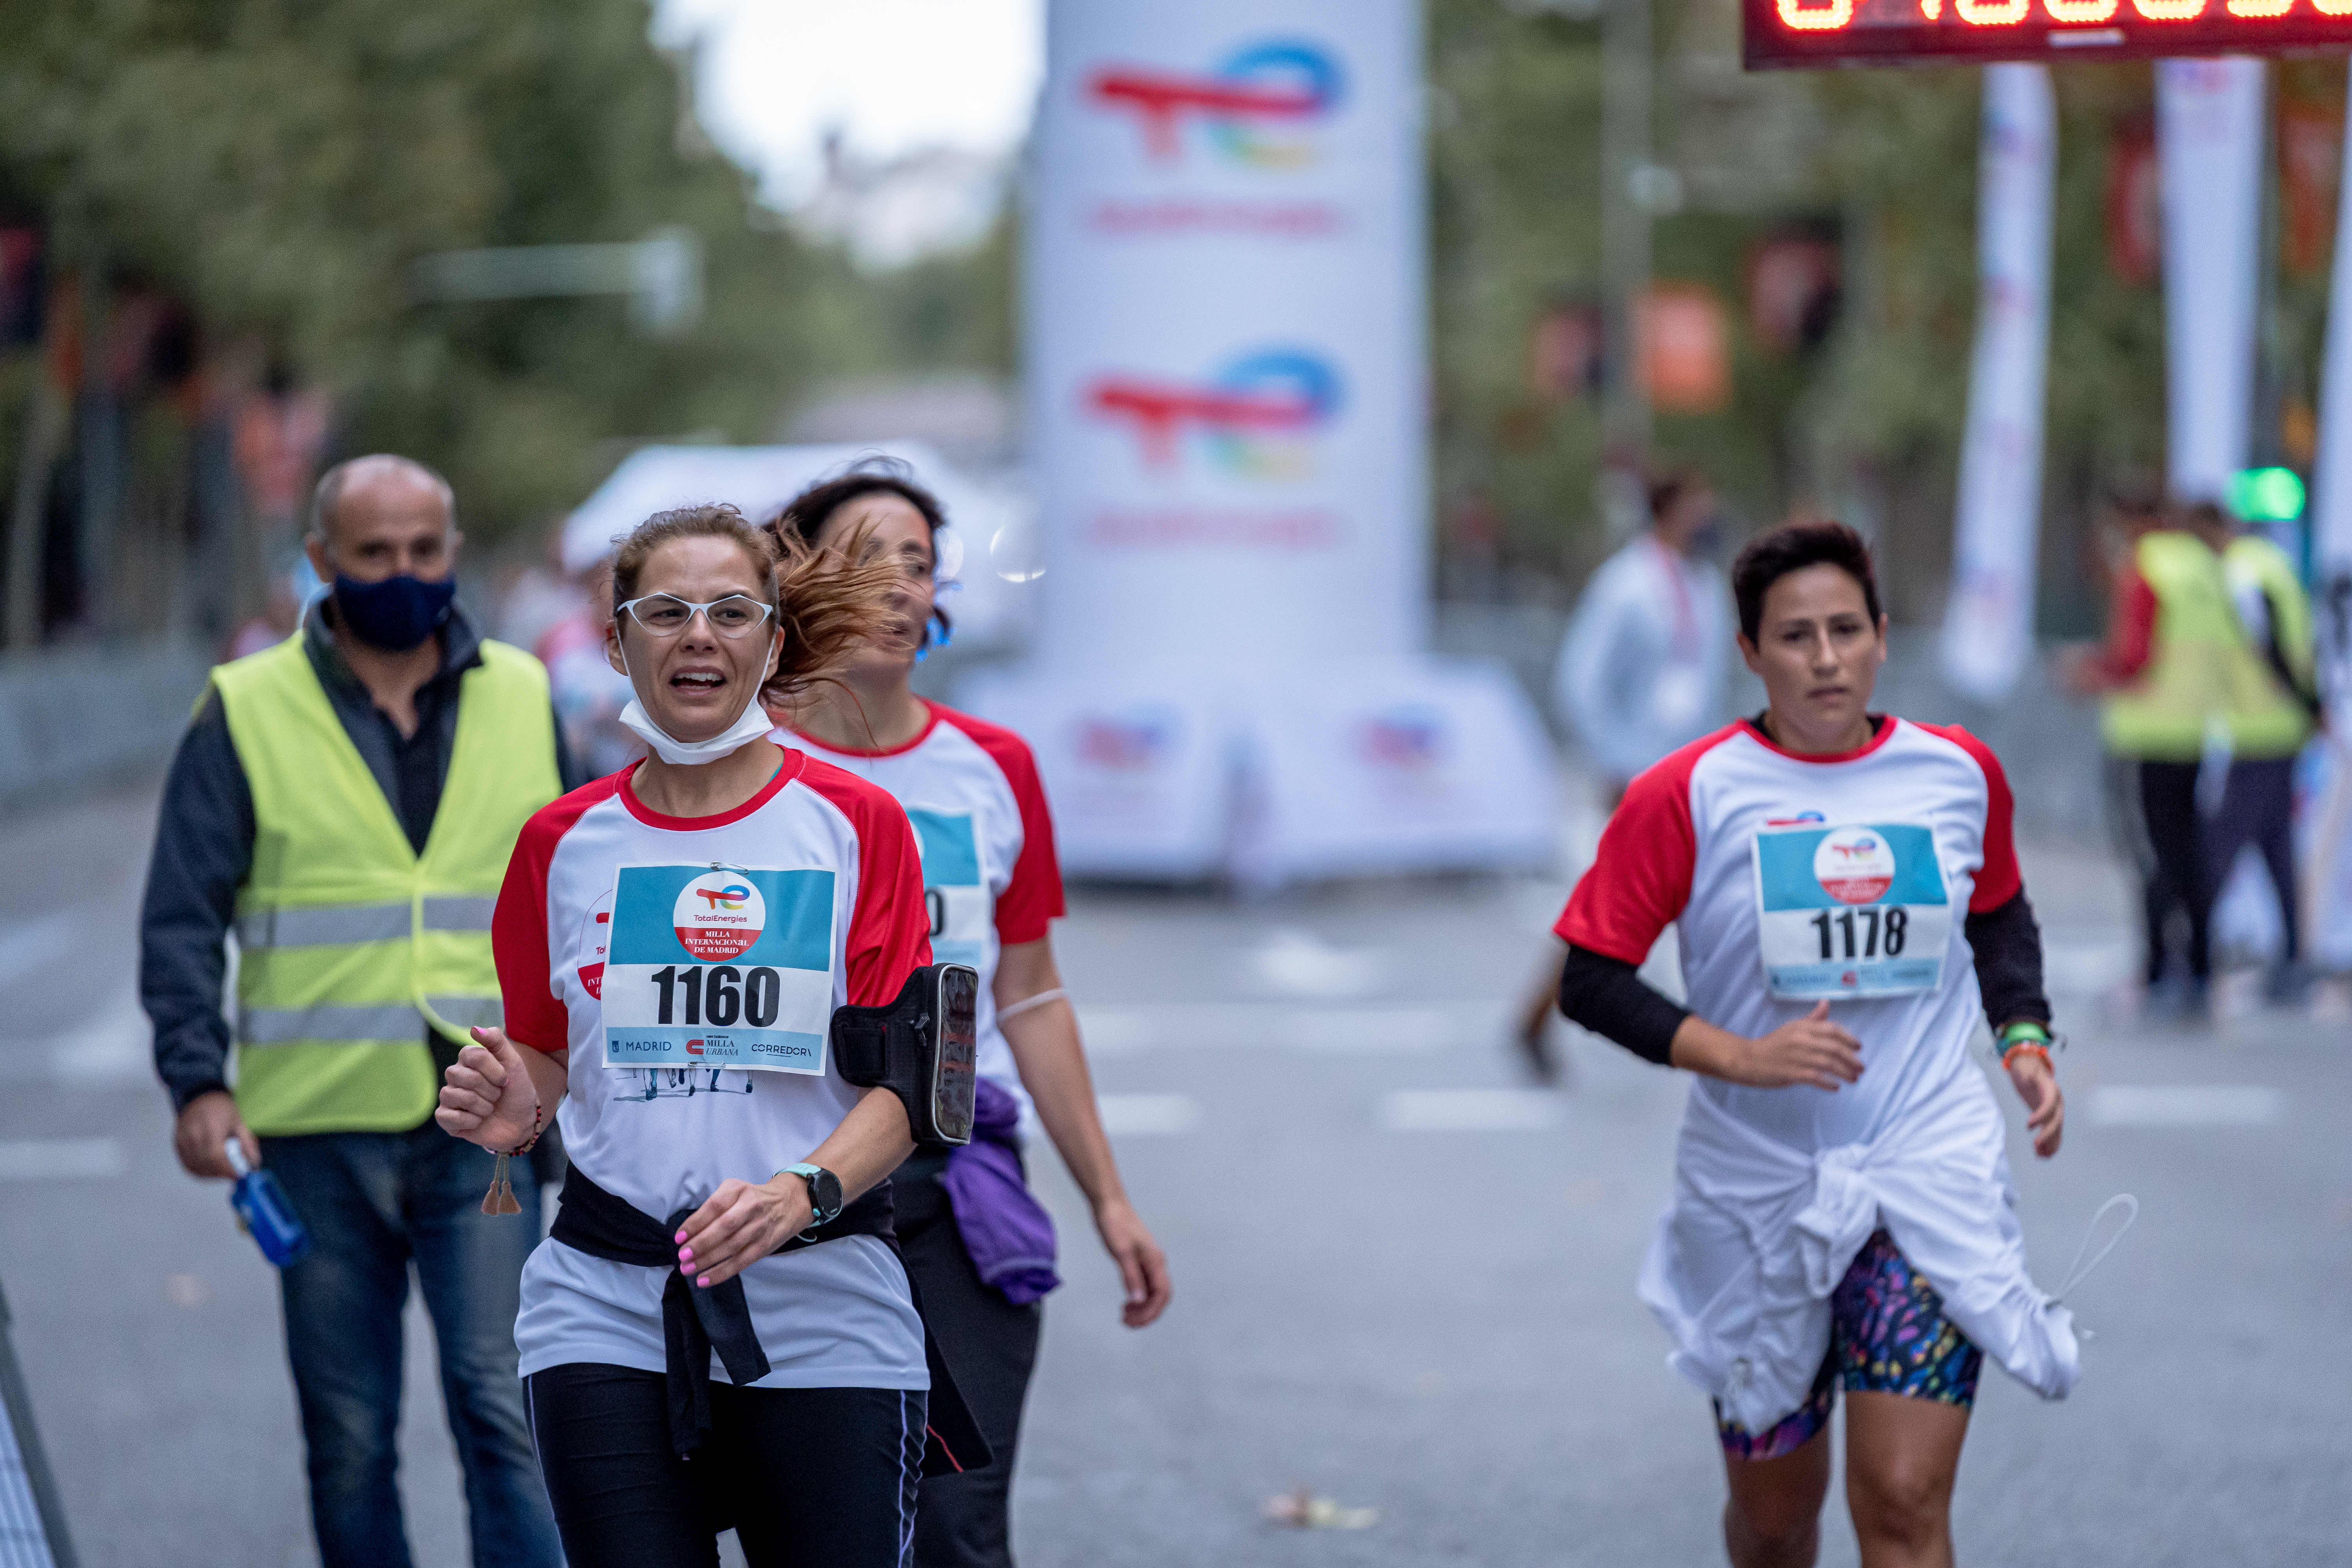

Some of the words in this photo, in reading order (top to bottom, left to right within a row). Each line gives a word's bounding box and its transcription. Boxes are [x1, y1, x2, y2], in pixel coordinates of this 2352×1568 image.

[693, 915, 748, 924] TotalEnergies
[1811, 907, 1908, 959] 1178
[651, 965, 780, 1027] 1160
[626, 1041, 672, 1051] MADRID
[706, 1048, 739, 1056] URBANA
